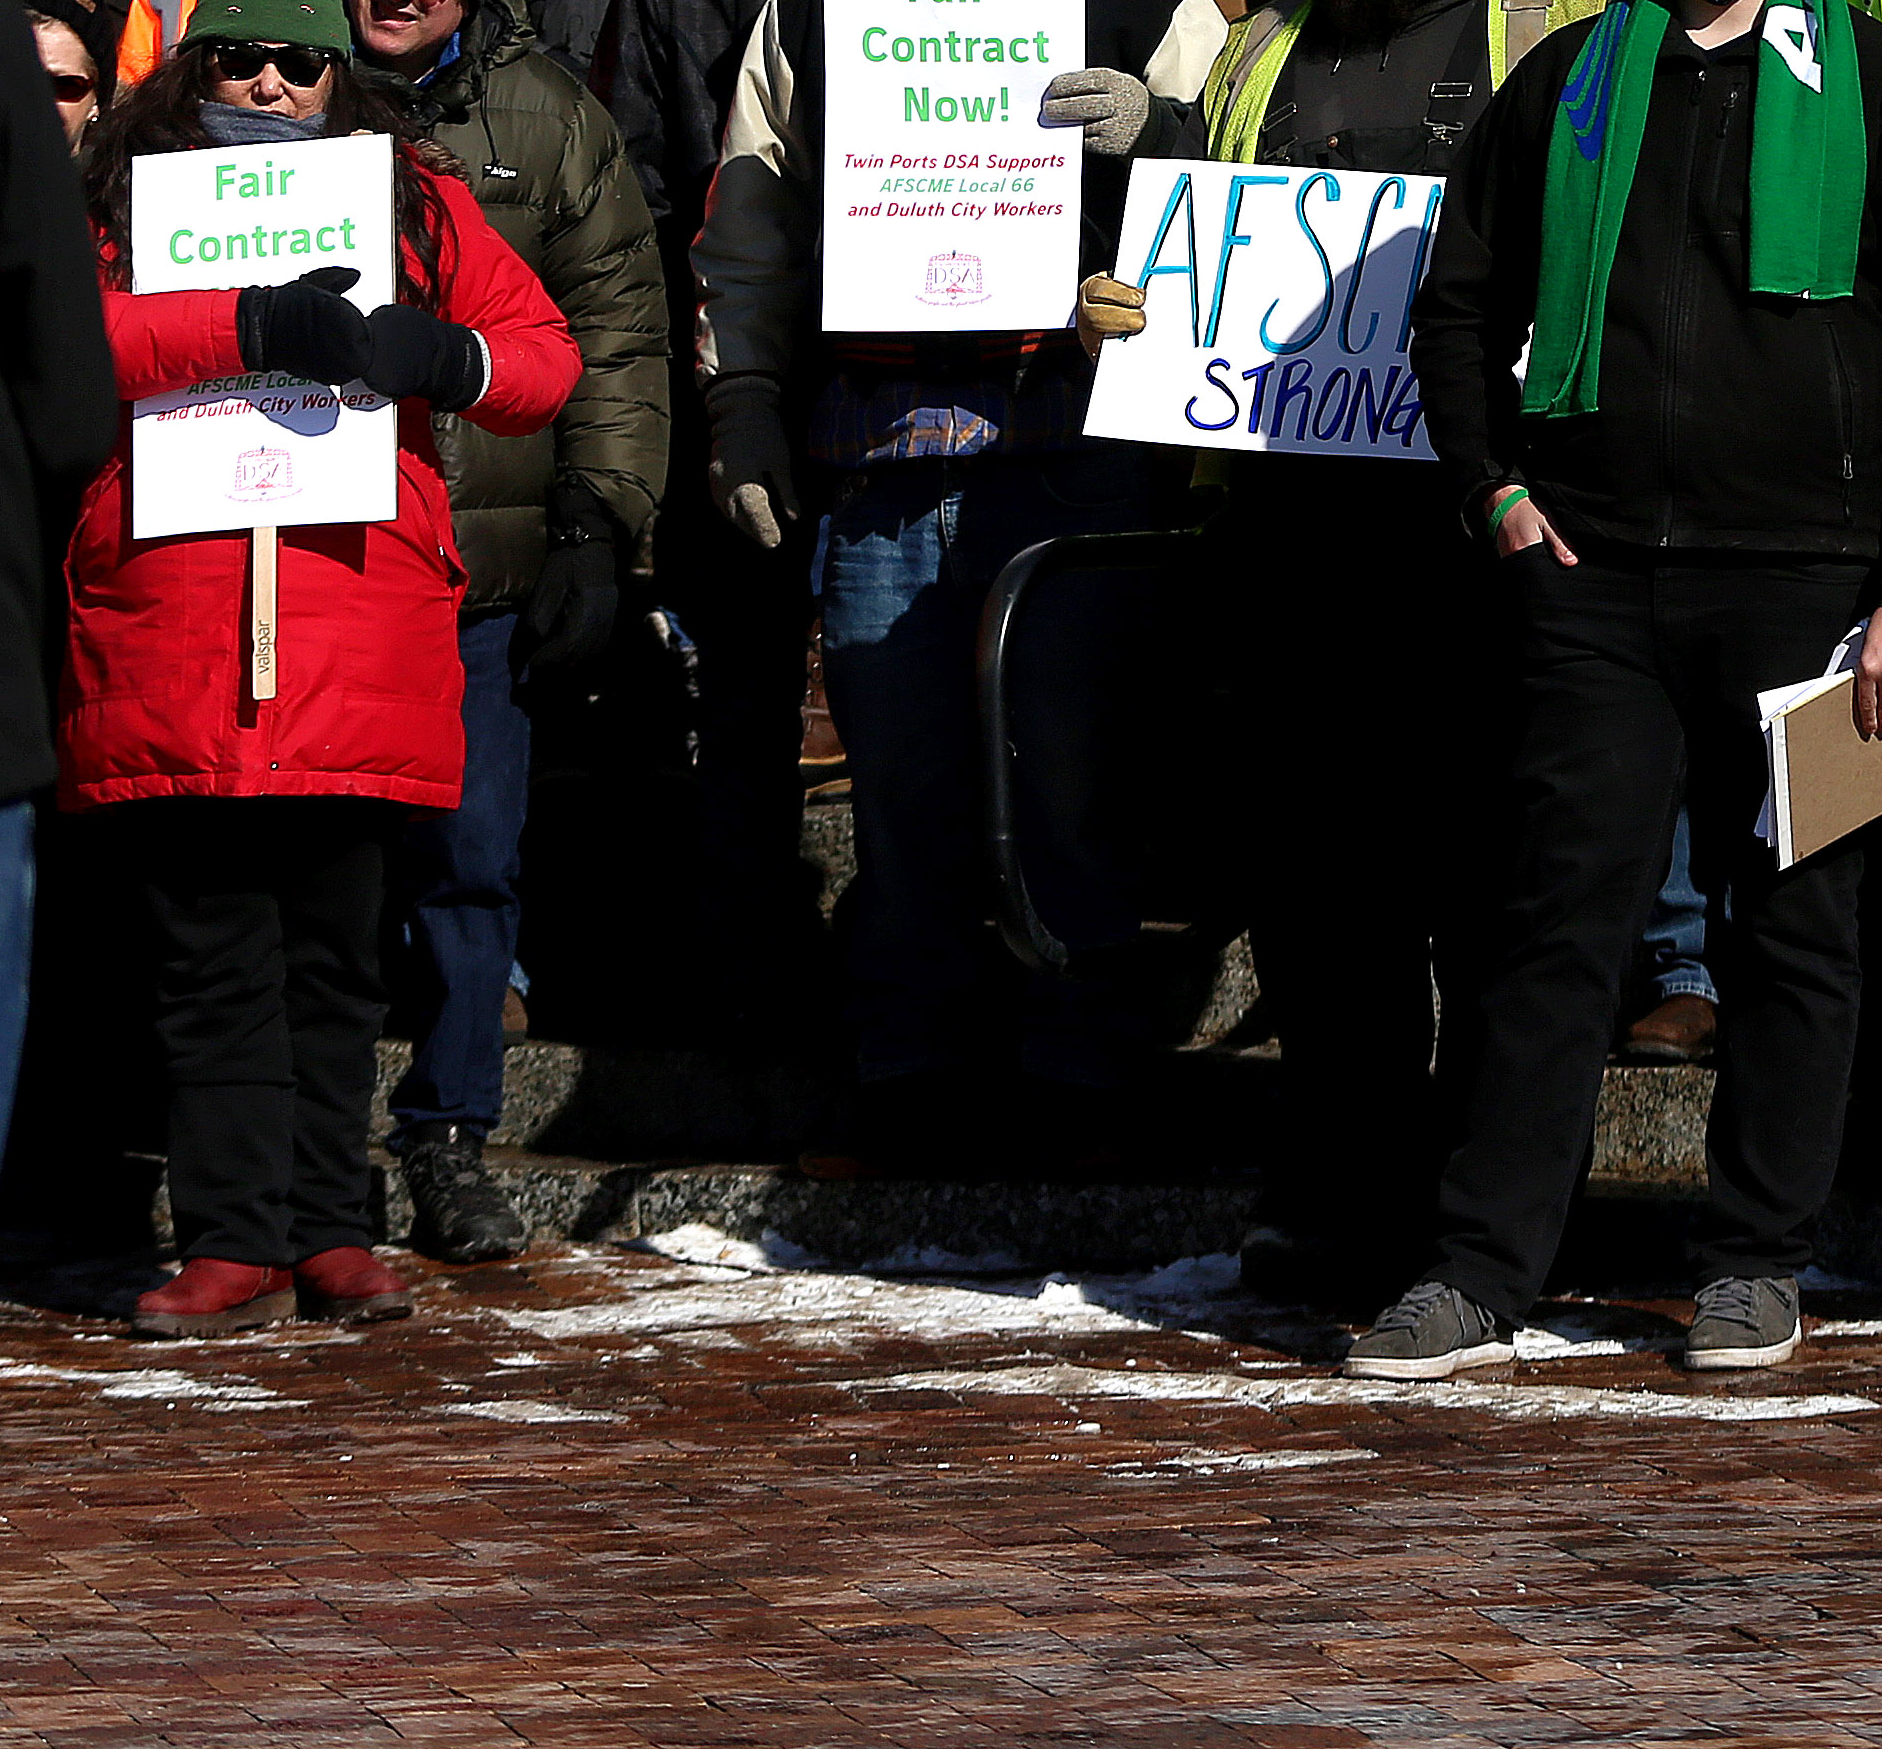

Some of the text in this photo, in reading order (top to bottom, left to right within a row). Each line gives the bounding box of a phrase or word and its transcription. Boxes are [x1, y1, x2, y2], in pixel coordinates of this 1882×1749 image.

[862, 26, 1049, 63] Contract
[904, 86, 1009, 123] Now!
[215, 160, 296, 200] Fair
[845, 153, 1065, 172] Twin Ports DSA Supports
[880, 177, 1035, 193] AFSCME Local 66
[848, 201, 1063, 220] and Duluth City Workers
[169, 217, 356, 264] Contract
[187, 373, 261, 397] AFSCME
[157, 390, 376, 423] and Duluth City Workers
[1185, 358, 1425, 448] STRONG
